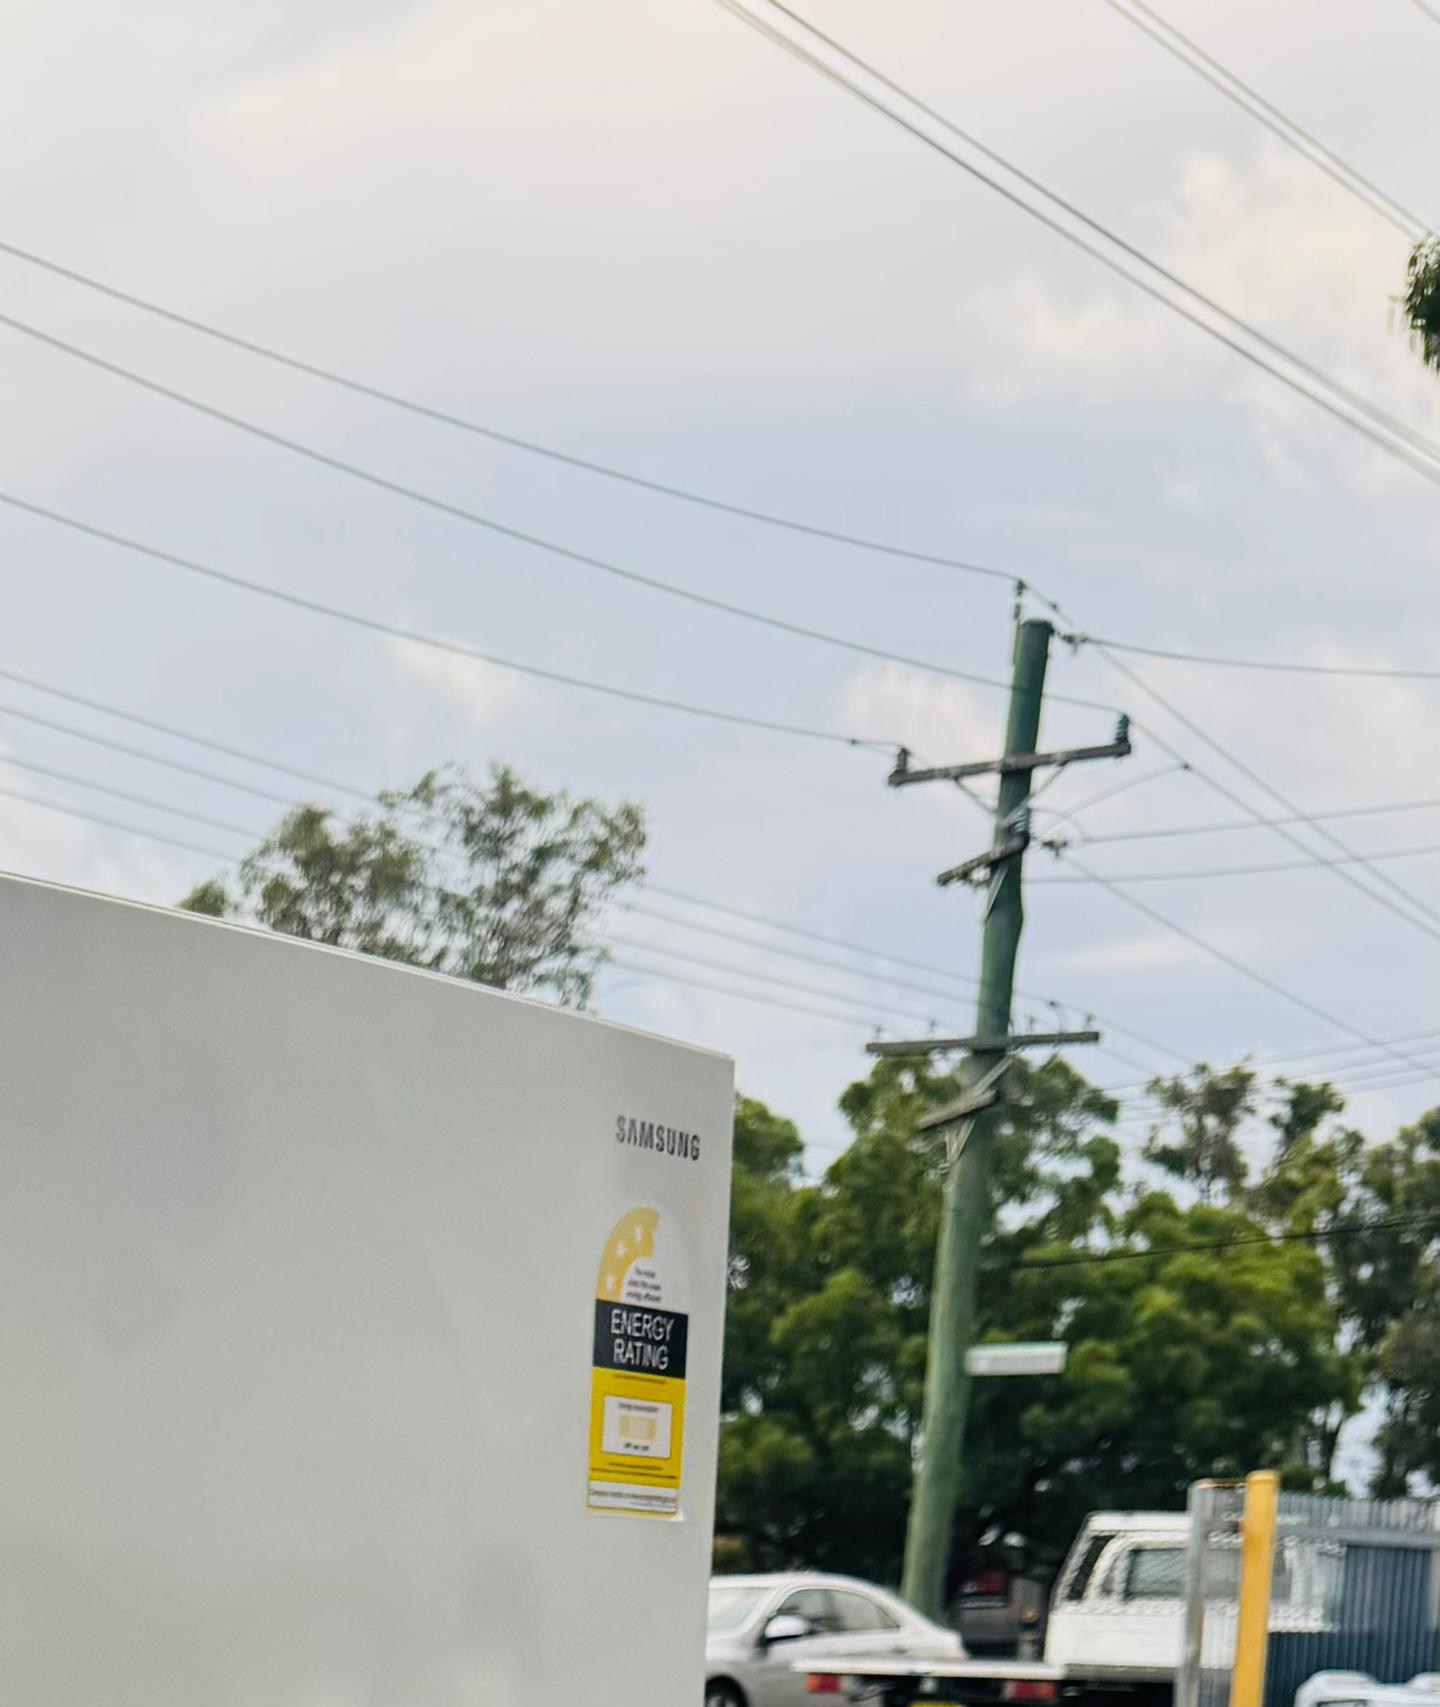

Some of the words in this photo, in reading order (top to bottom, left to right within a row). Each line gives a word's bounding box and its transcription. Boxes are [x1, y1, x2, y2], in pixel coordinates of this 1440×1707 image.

[616, 1114, 700, 1161] SAMSUNG
[611, 1309, 675, 1341] ENERGY
[613, 1338, 669, 1370] RATING
